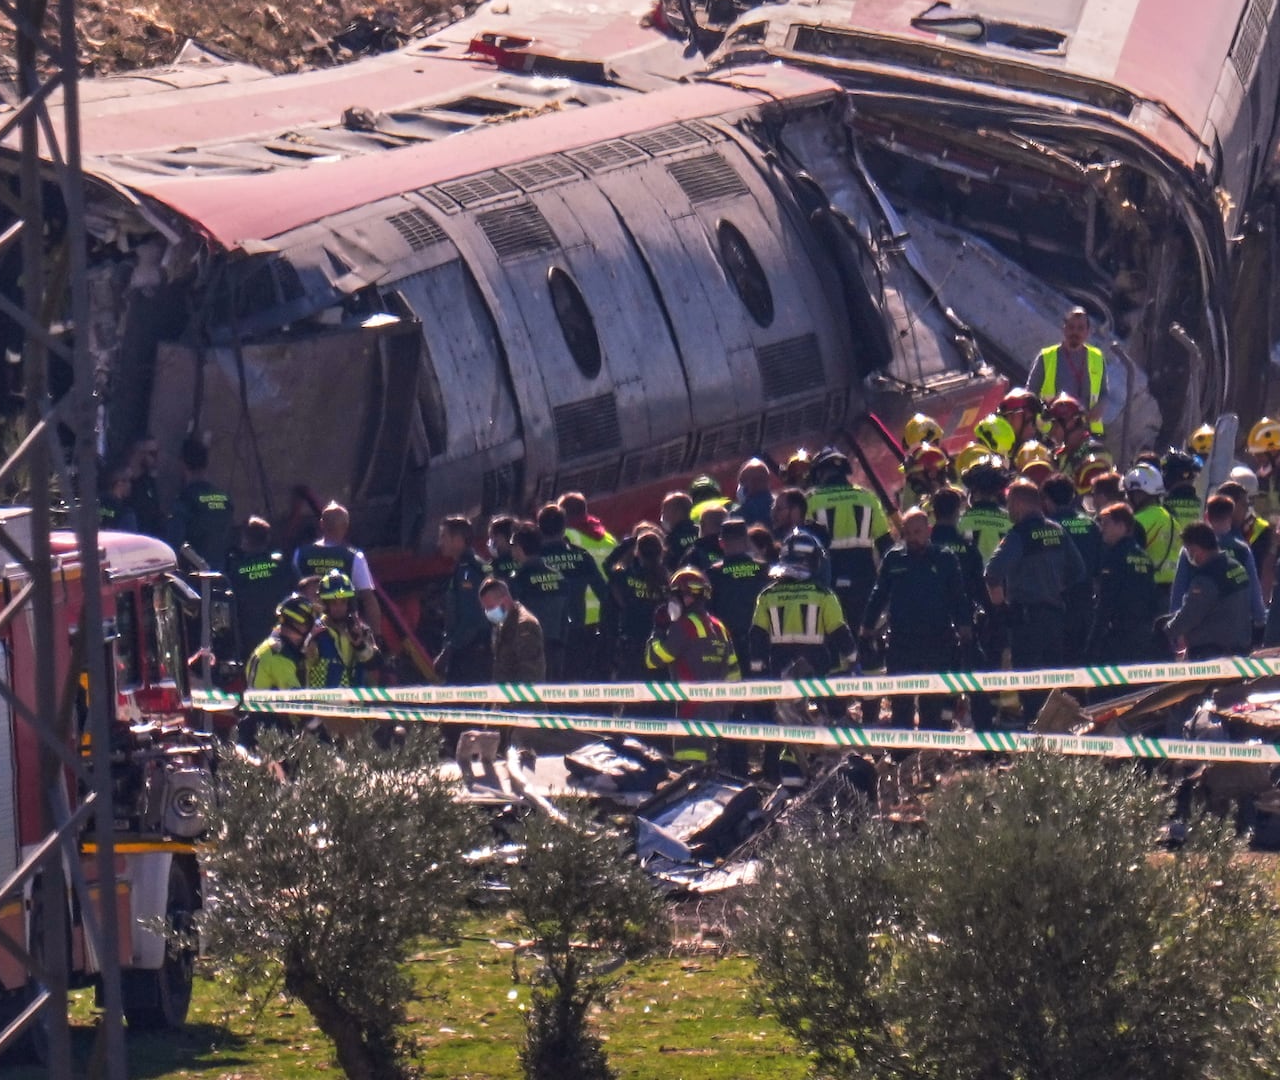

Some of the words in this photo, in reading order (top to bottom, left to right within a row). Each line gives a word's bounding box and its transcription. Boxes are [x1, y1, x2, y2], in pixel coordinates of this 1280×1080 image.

[239, 562, 278, 574] GUARDIA
[723, 563, 760, 575] GUARDIA
[250, 571, 272, 580] CIVIL
[1127, 669, 1152, 679] PASAR
[1155, 668, 1165, 677] NO
[1168, 667, 1186, 677] CIVIL
[1188, 665, 1221, 676] GUARDIA
[982, 676, 1007, 686] PASAR
[1010, 676, 1019, 685] NO
[1022, 674, 1040, 685] CIVIL
[1042, 673, 1074, 684] GUARDIA
[836, 682, 860, 692] PASAR
[862, 681, 873, 691] NO
[876, 680, 894, 690] CIVIL
[896, 679, 930, 689] GUARDIA
[871, 732, 895, 742] PASAR
[898, 733, 908, 743] NO
[911, 733, 930, 743] CIVIL
[932, 734, 966, 745] GUARDIA
[1168, 744, 1194, 755] PASAR
[1196, 745, 1206, 755] NO
[1209, 745, 1227, 756] CIVIL
[1229, 746, 1262, 757] GUARDIA
